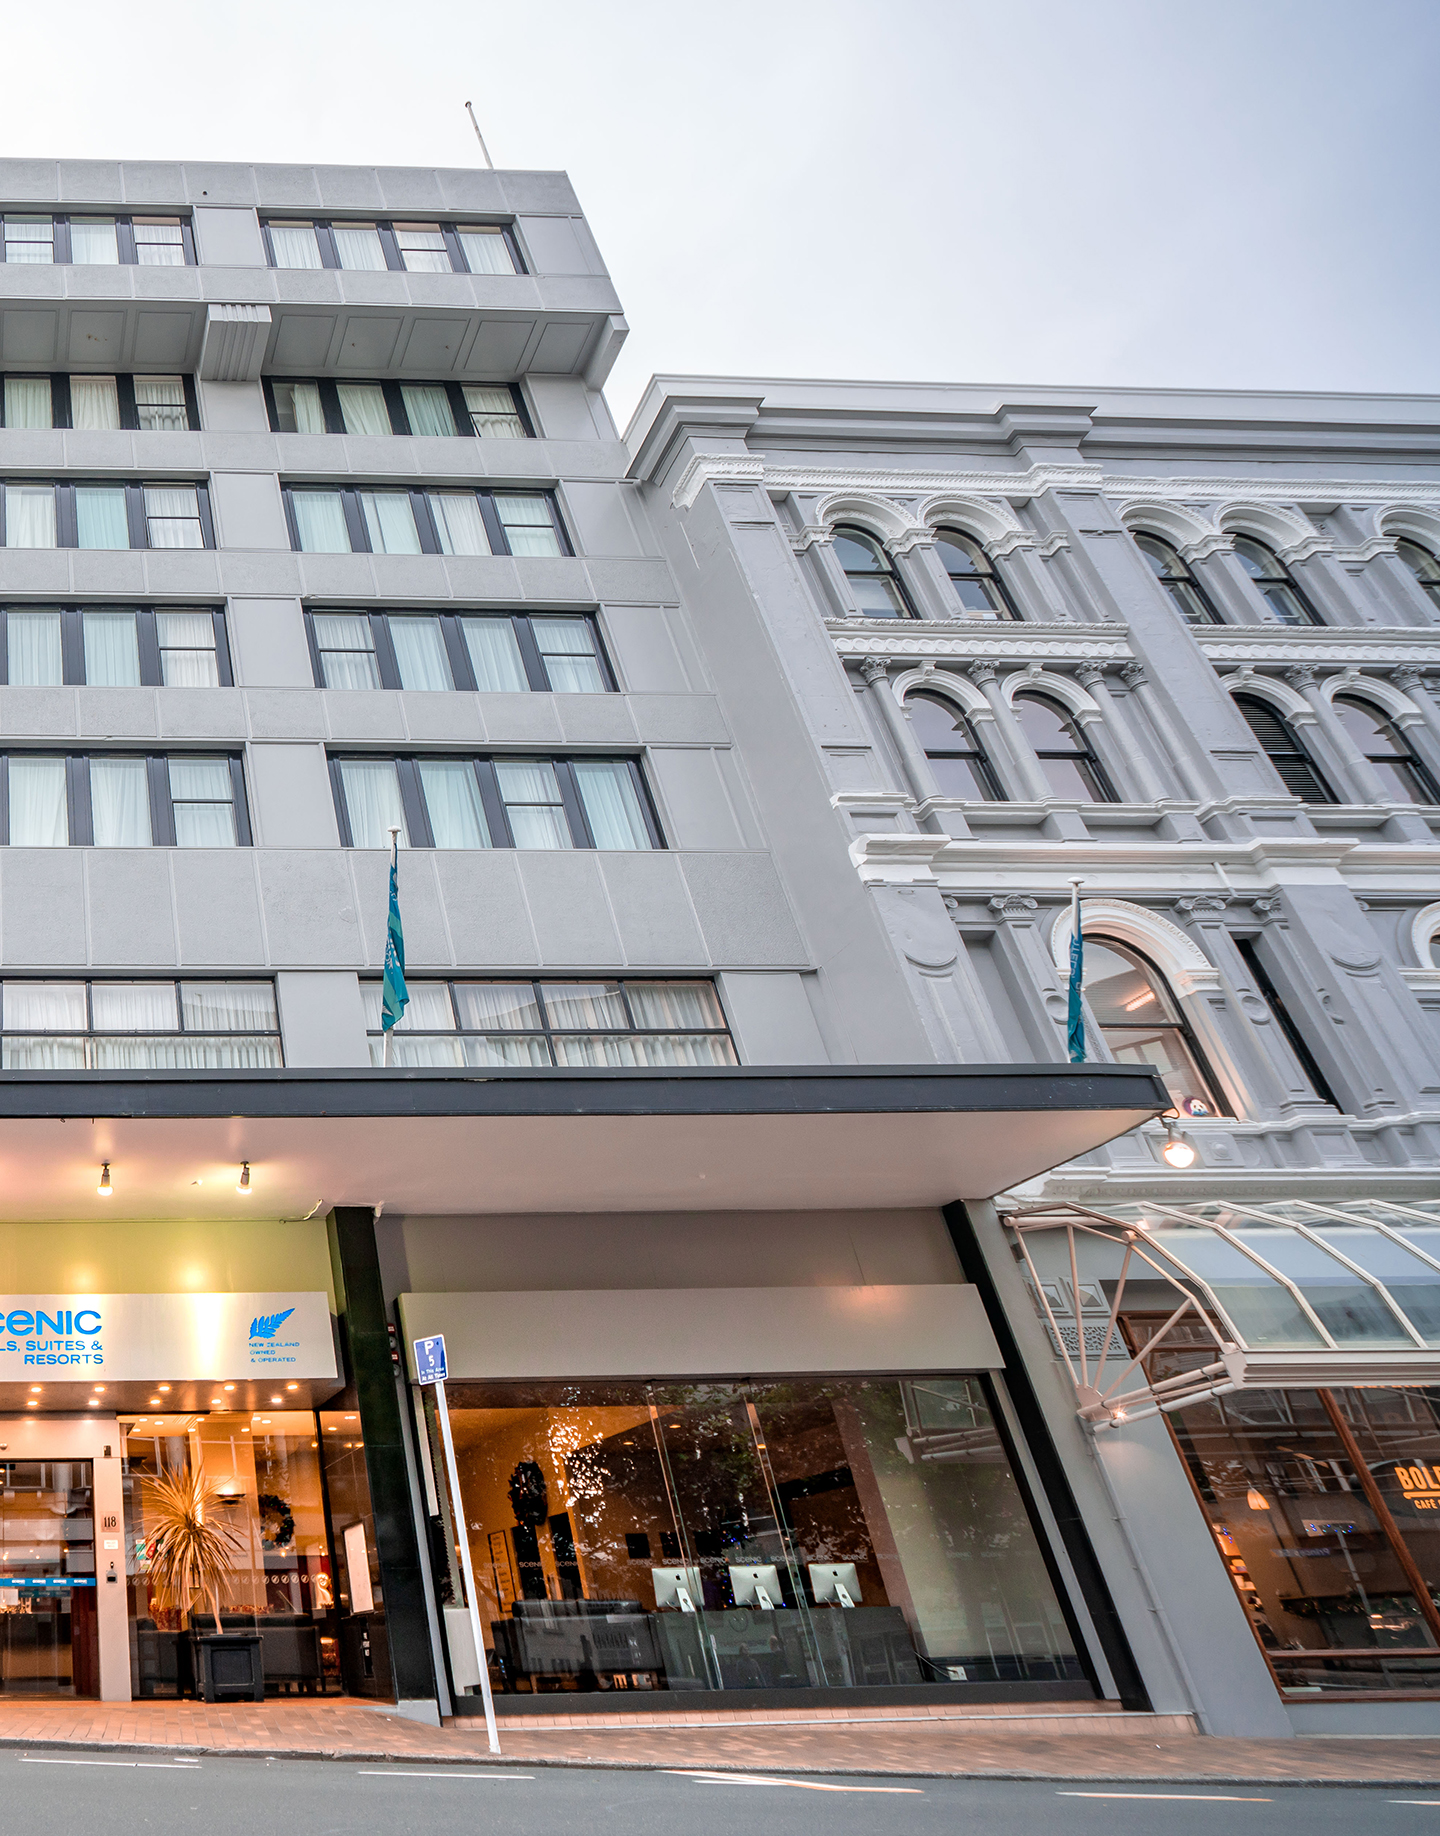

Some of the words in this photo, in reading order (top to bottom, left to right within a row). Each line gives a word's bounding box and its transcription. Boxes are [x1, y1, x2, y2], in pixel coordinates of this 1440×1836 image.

[25, 1340, 86, 1351] SUITES
[90, 1340, 103, 1351] &
[424, 1340, 434, 1355] P
[24, 1354, 104, 1365] RESORTS
[428, 1355, 435, 1366] 5
[104, 1515, 117, 1528] 118
